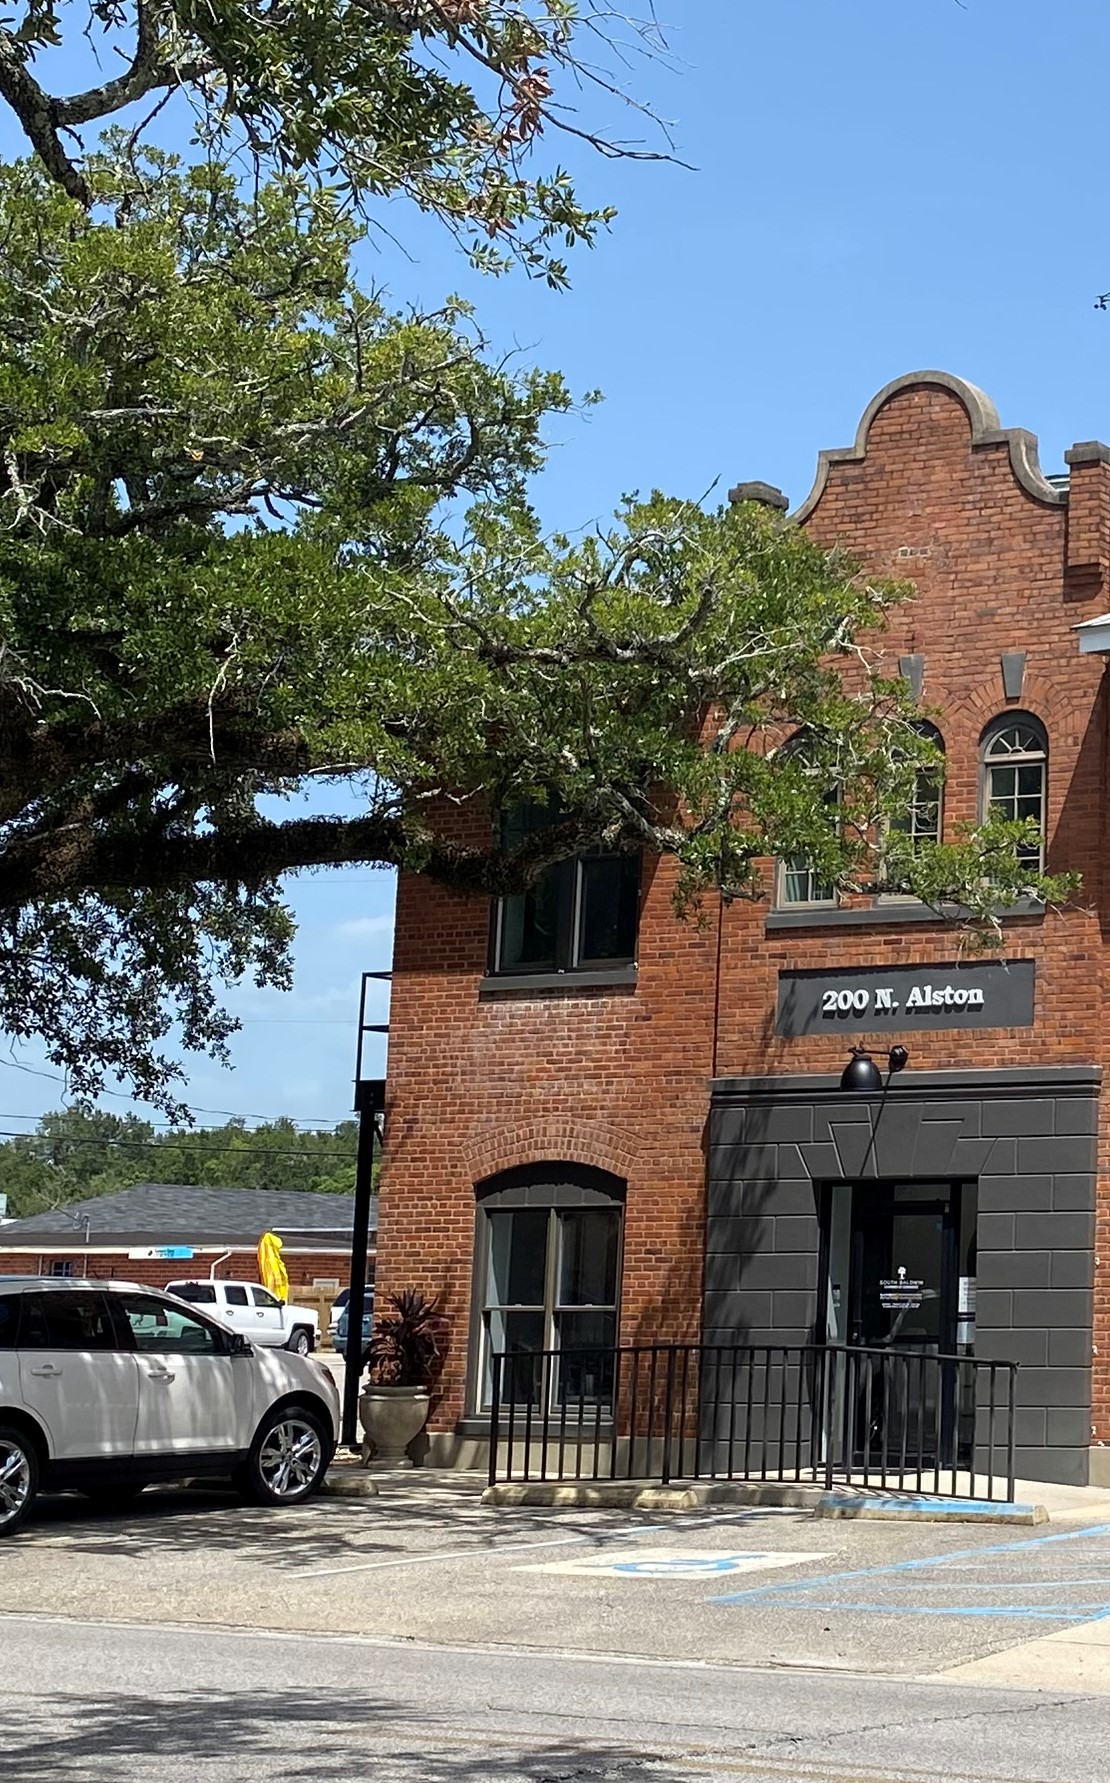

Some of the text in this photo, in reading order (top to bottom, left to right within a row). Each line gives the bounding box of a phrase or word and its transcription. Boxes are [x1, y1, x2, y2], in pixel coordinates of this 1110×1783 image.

[822, 984, 985, 1012] 200 N. Alston
